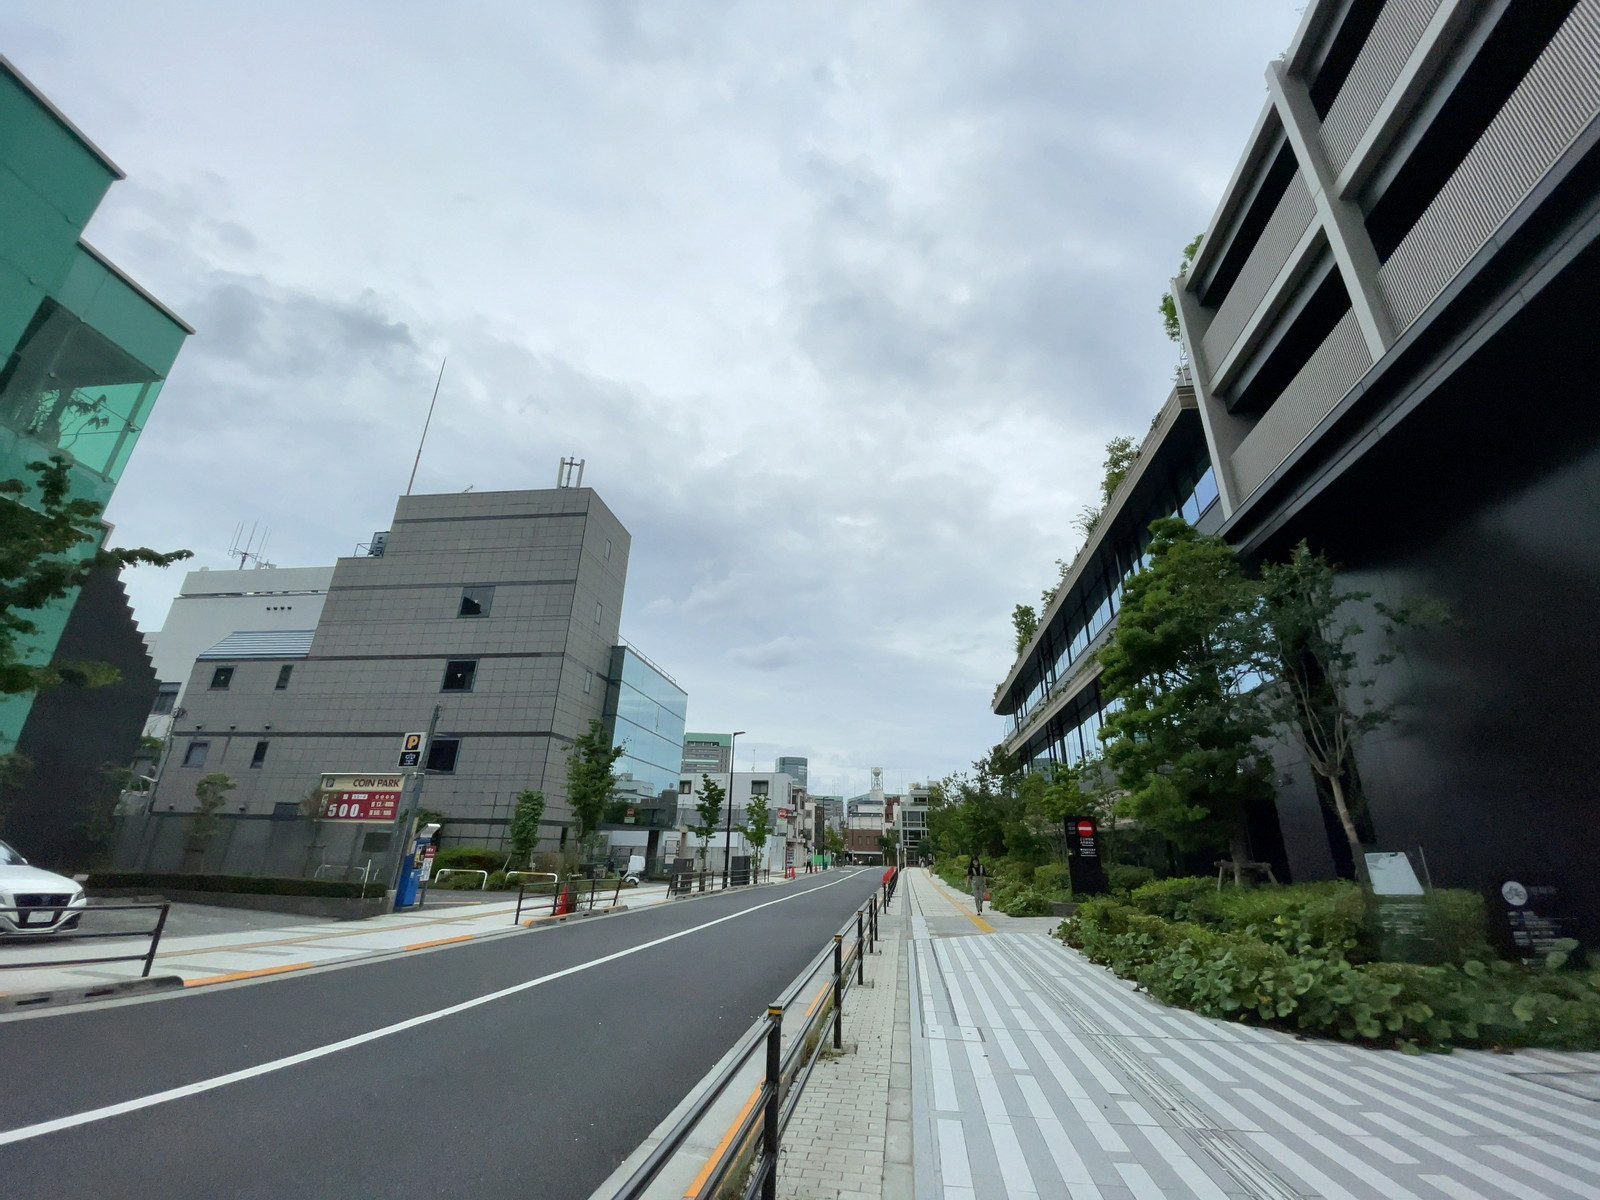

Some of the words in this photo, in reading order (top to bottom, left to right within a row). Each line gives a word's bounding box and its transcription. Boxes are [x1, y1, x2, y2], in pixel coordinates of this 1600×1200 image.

[353, 779, 375, 787] COIN
[377, 779, 400, 787] PARK
[327, 803, 360, 817] 500
